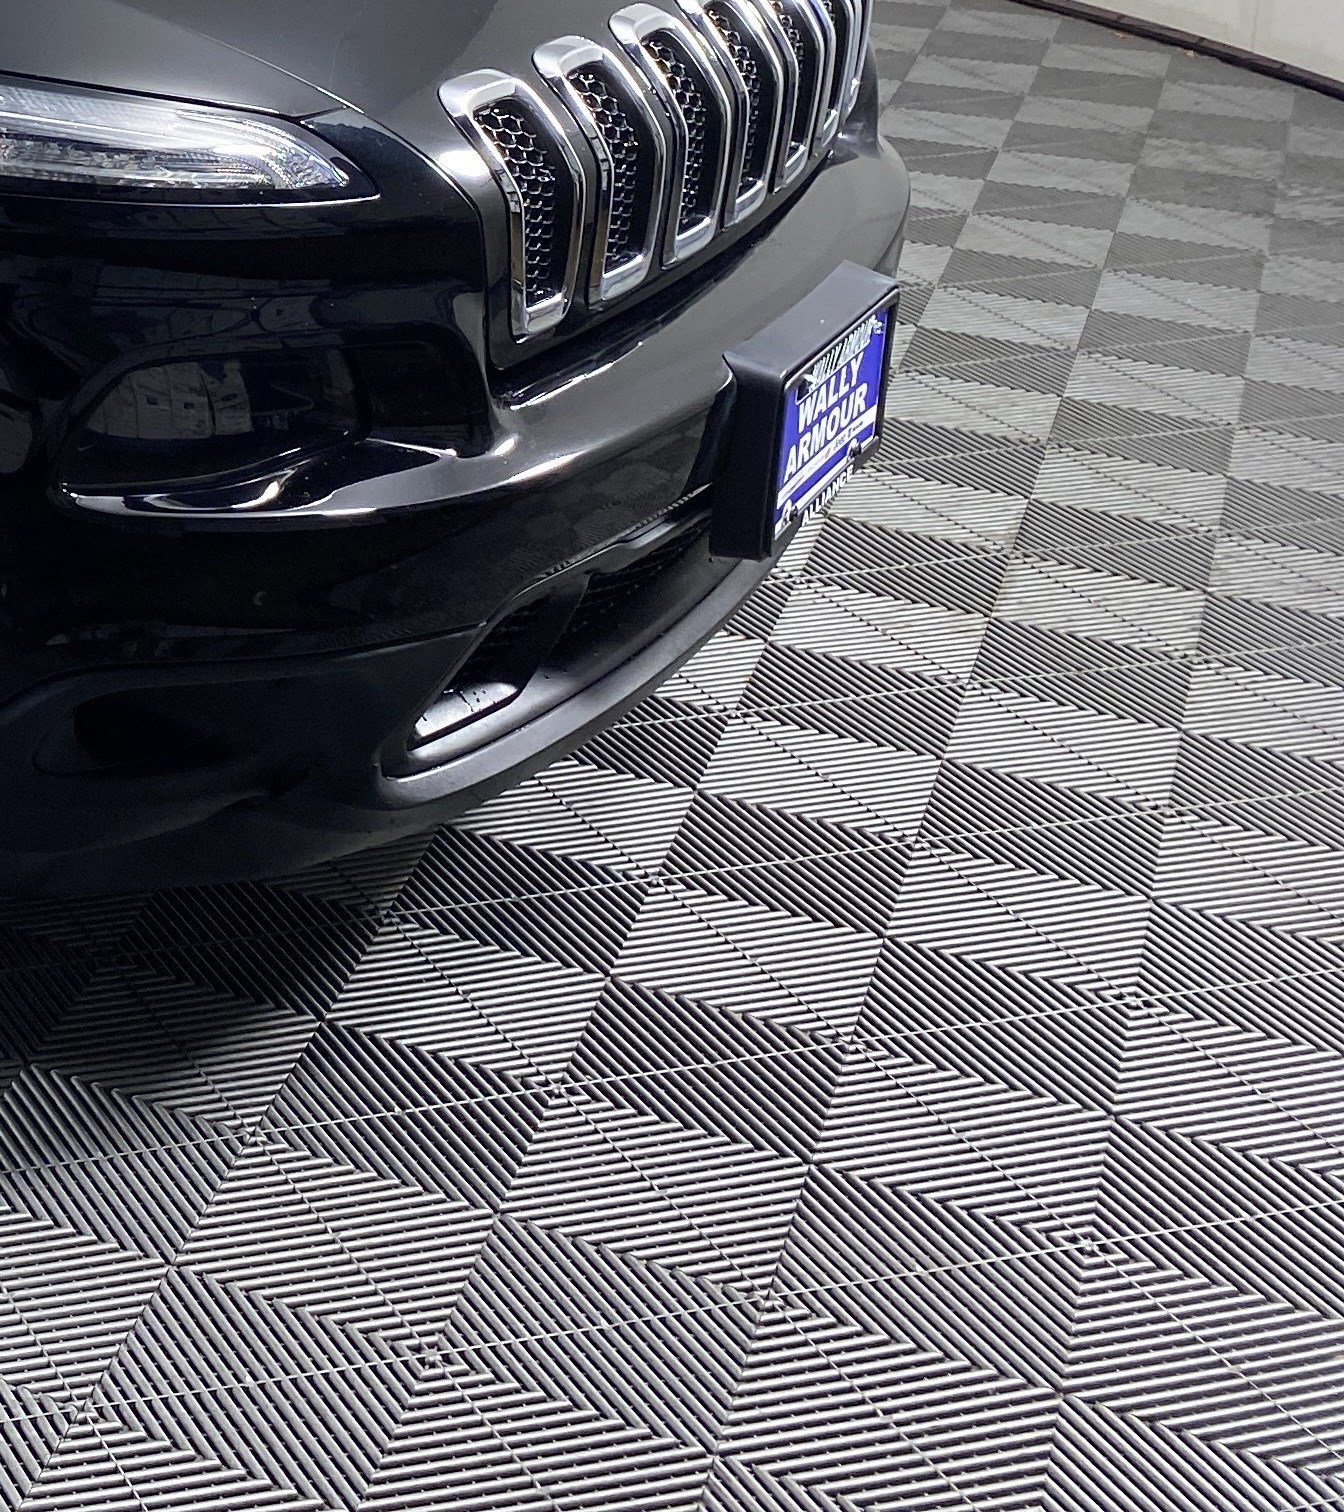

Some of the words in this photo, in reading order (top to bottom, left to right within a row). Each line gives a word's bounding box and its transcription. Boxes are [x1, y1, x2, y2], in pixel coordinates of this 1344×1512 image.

[784, 383, 869, 481] ARMOUR
[799, 352, 864, 433] WALLY
[801, 465, 854, 527] ALLIANCE
